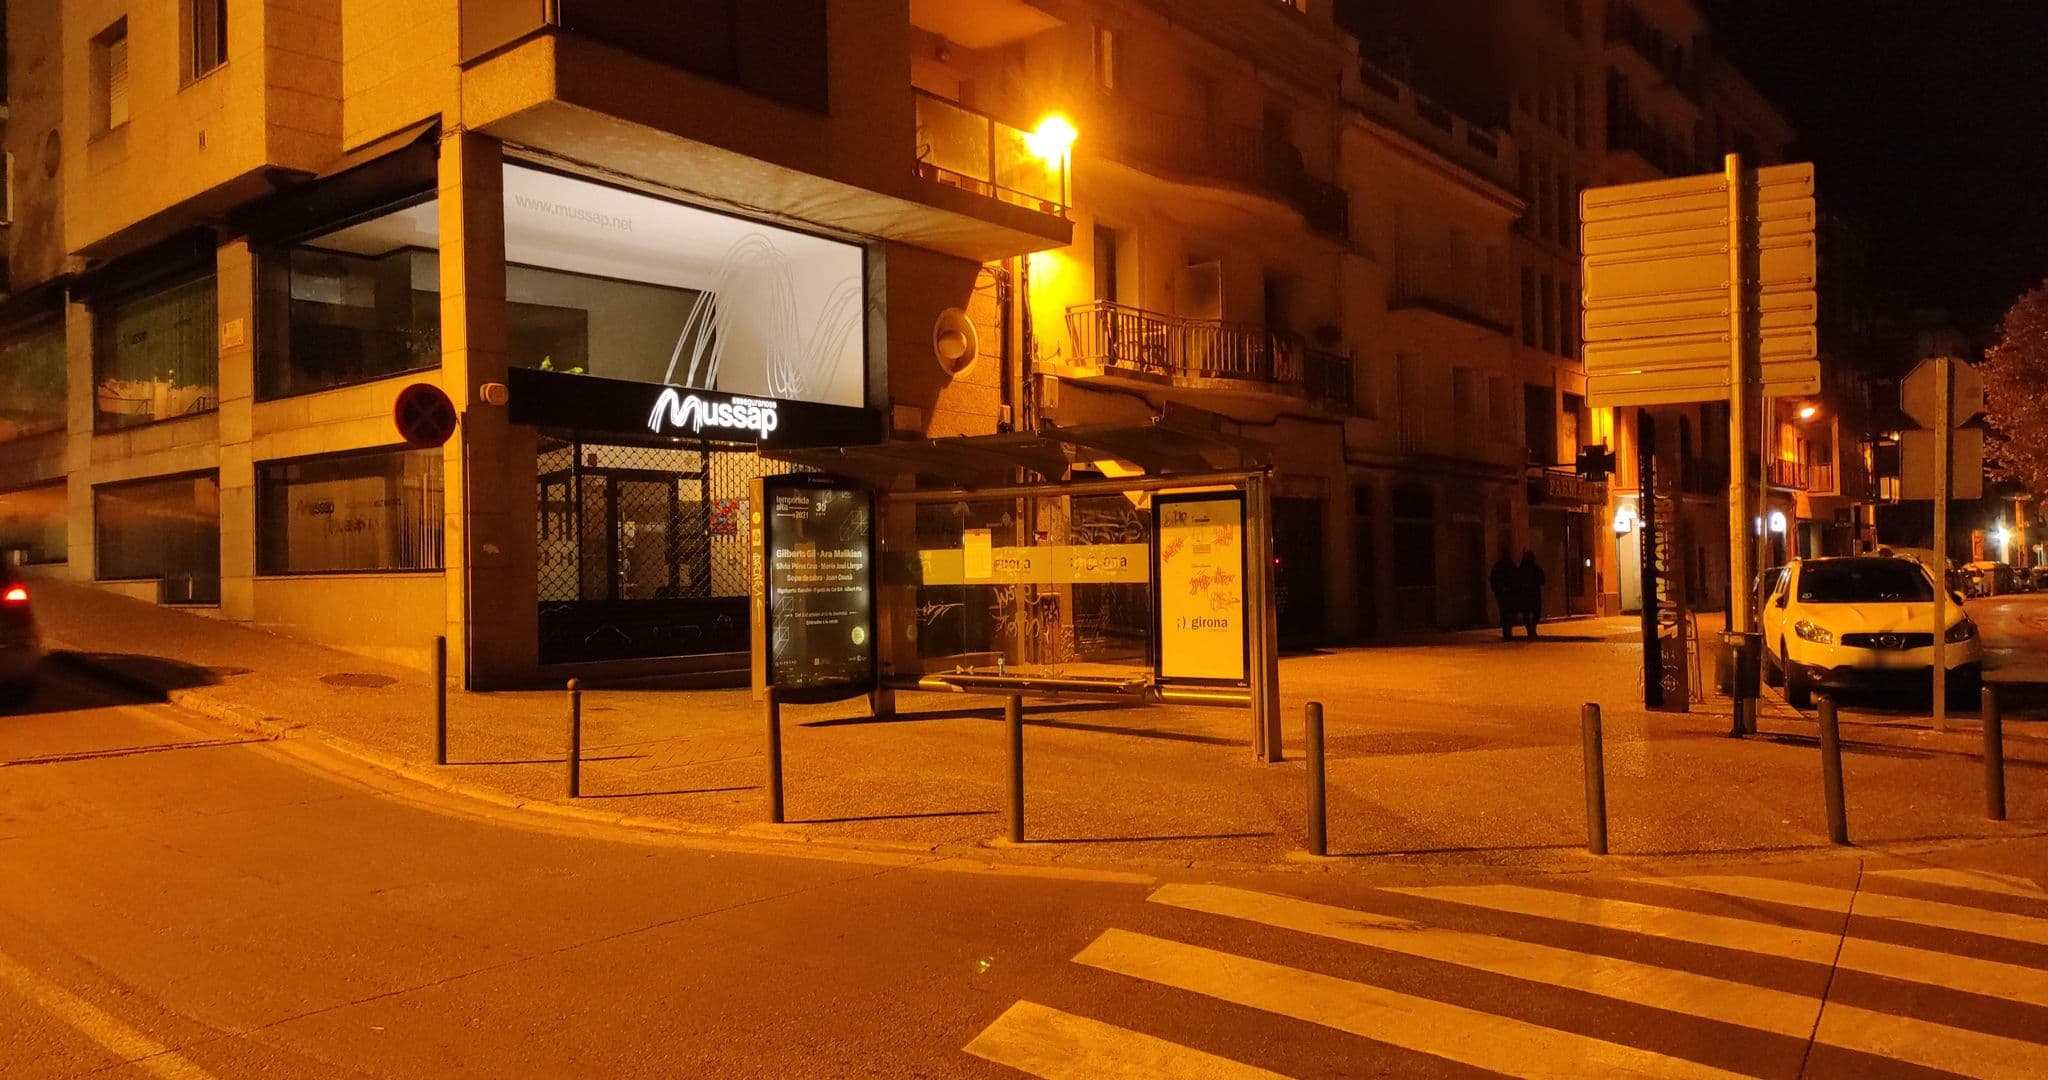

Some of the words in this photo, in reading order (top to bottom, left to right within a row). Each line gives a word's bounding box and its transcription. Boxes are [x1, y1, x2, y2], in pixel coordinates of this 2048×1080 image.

[514, 193, 632, 231] www.mussap.net
[648, 388, 777, 439] Mussap
[776, 502, 789, 511] alta
[776, 548, 805, 558] Gilberto
[806, 549, 816, 558] Gil
[820, 549, 833, 558] Ara
[833, 548, 862, 558] Malikian
[1191, 615, 1228, 631] girona
